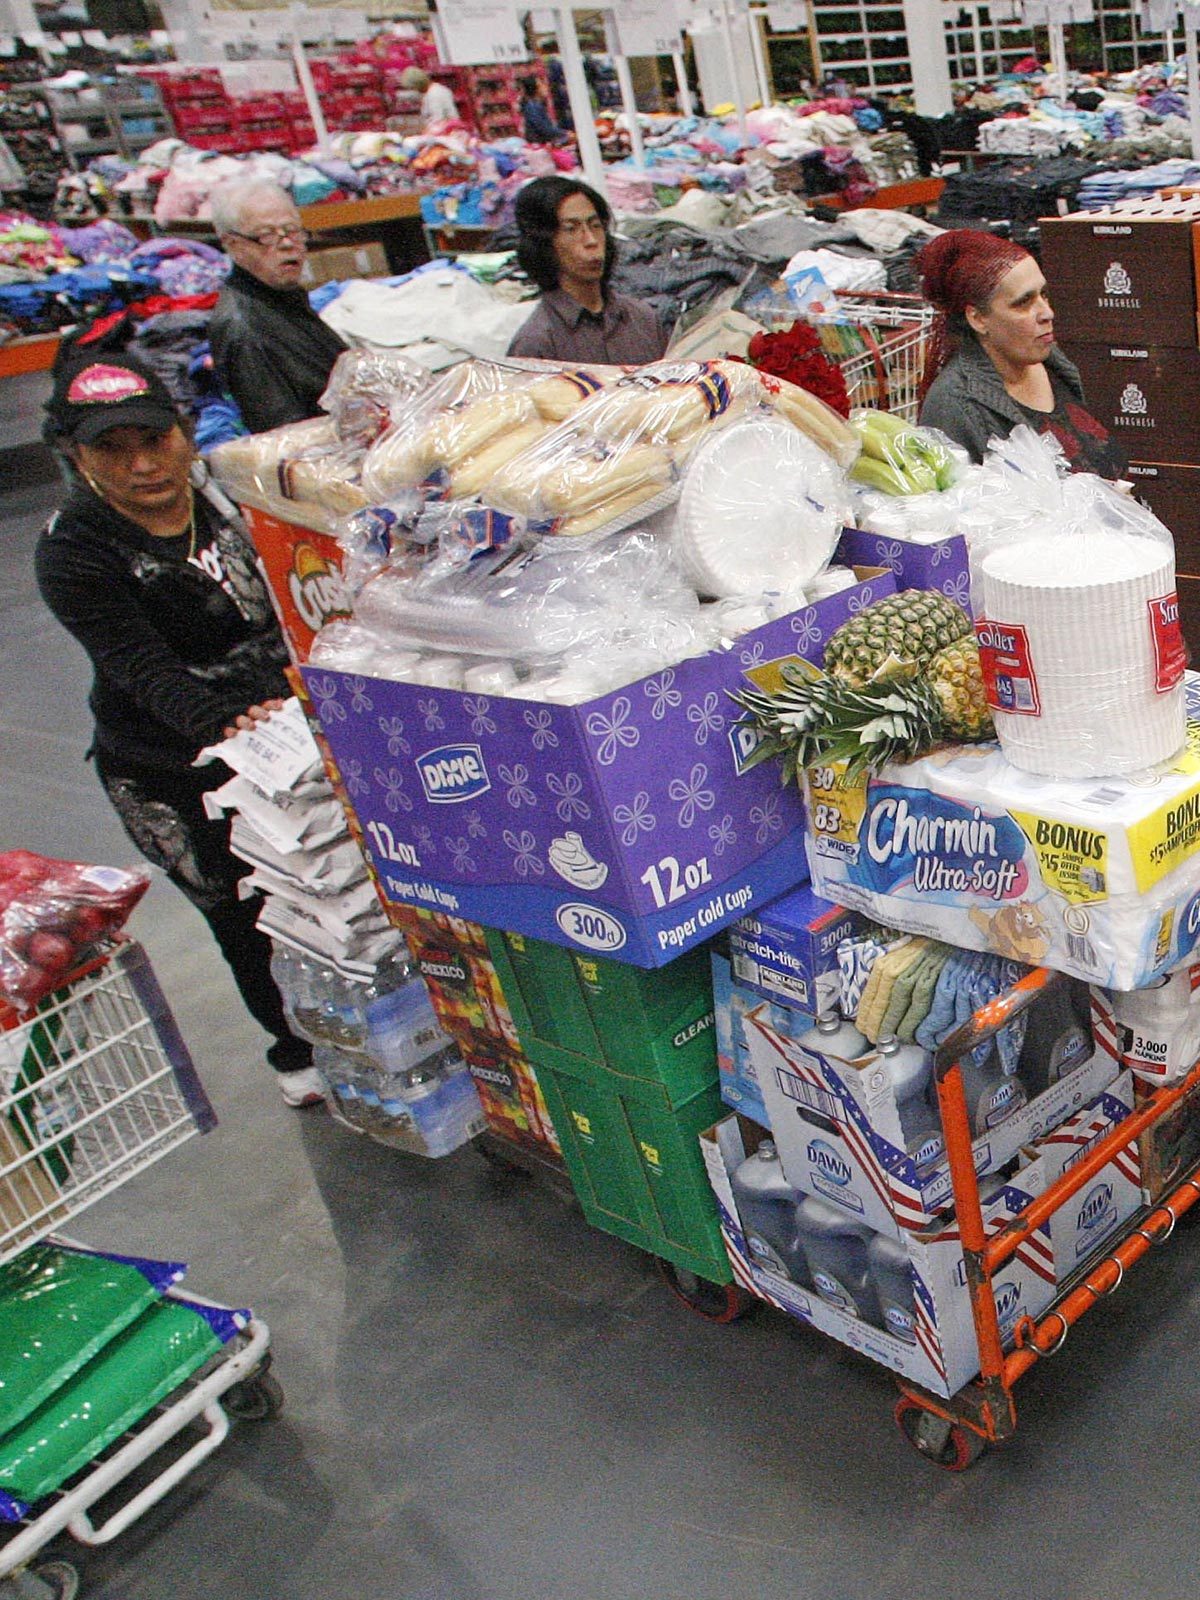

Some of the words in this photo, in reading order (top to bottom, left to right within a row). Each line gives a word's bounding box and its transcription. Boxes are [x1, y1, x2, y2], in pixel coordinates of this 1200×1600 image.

[1093, 226, 1132, 235] KIRKLAND
[1098, 298, 1141, 308] BORGHESE
[1111, 349, 1149, 358] KIRKLAND
[1114, 416, 1156, 428] BORGHESE
[812, 767, 835, 791] 30
[814, 803, 842, 834] 83
[868, 798, 999, 864] Charmin
[1036, 819, 1107, 861] BONUS
[367, 820, 422, 869] 12oz
[1040, 851, 1060, 873] $15
[1060, 861, 1081, 872] OFFER
[1061, 852, 1085, 866] SAMPLE
[640, 856, 713, 909] 12oz
[914, 856, 968, 892] Ultra
[970, 859, 1020, 900] Soft
[1059, 870, 1080, 881] INSIDE
[386, 874, 412, 899] Paper
[415, 881, 436, 902] Cold
[436, 886, 461, 910] Cups
[657, 916, 697, 950] Paper
[698, 896, 726, 928] Cold
[725, 884, 753, 912] Cups
[820, 921, 853, 953] 3000
[731, 935, 802, 970] stretch-tite
[420, 961, 466, 981] MEXICO
[764, 969, 804, 990] KIRKLAND
[673, 1012, 716, 1047] CLEAN
[1134, 1049, 1167, 1063] NAPKINS
[1135, 1037, 1168, 1054] 3,000
[469, 1065, 512, 1087] MEXICO
[991, 1083, 1015, 1107] DAWN
[806, 1144, 853, 1182] DAWN
[914, 1139, 941, 1163] DAWN
[1077, 1182, 1114, 1231] DAWN
